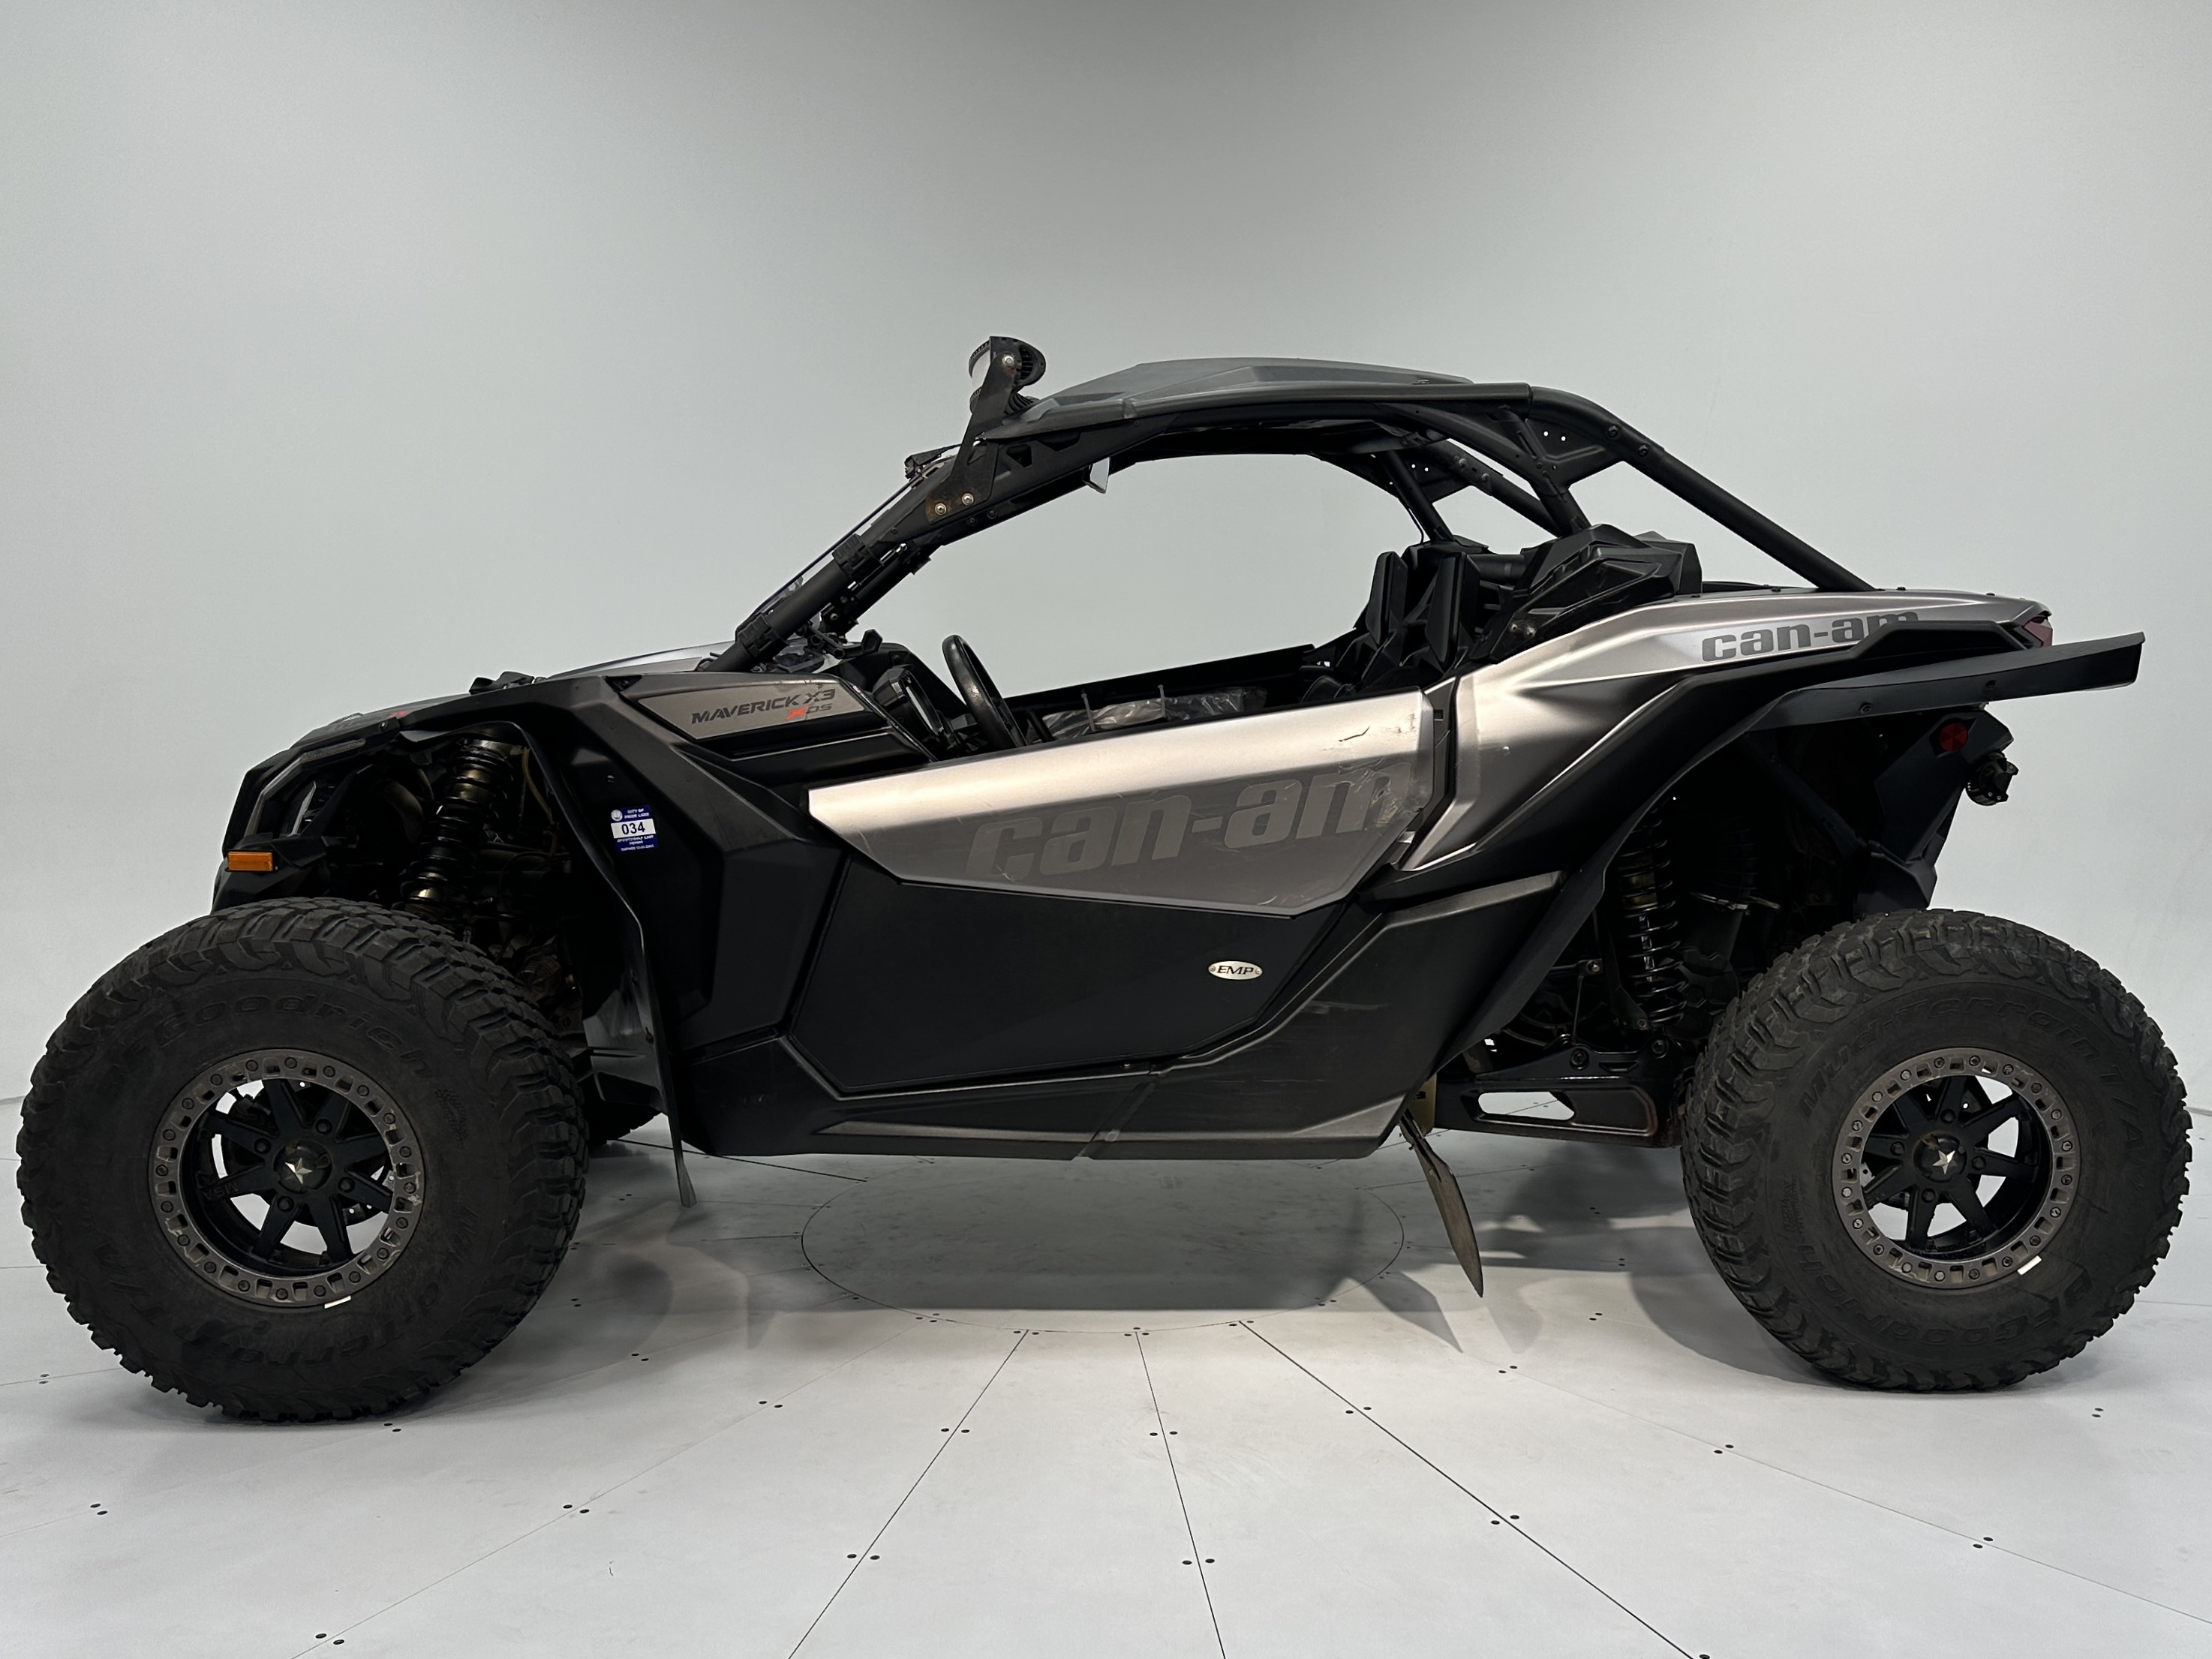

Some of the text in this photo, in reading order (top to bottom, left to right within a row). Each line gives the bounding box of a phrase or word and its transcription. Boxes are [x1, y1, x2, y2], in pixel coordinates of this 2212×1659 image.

[691, 688, 836, 724] MAVERICK X3
[621, 822, 645, 835] 034
[966, 762, 1412, 881] can-am
[1216, 965, 1254, 975] EMP
